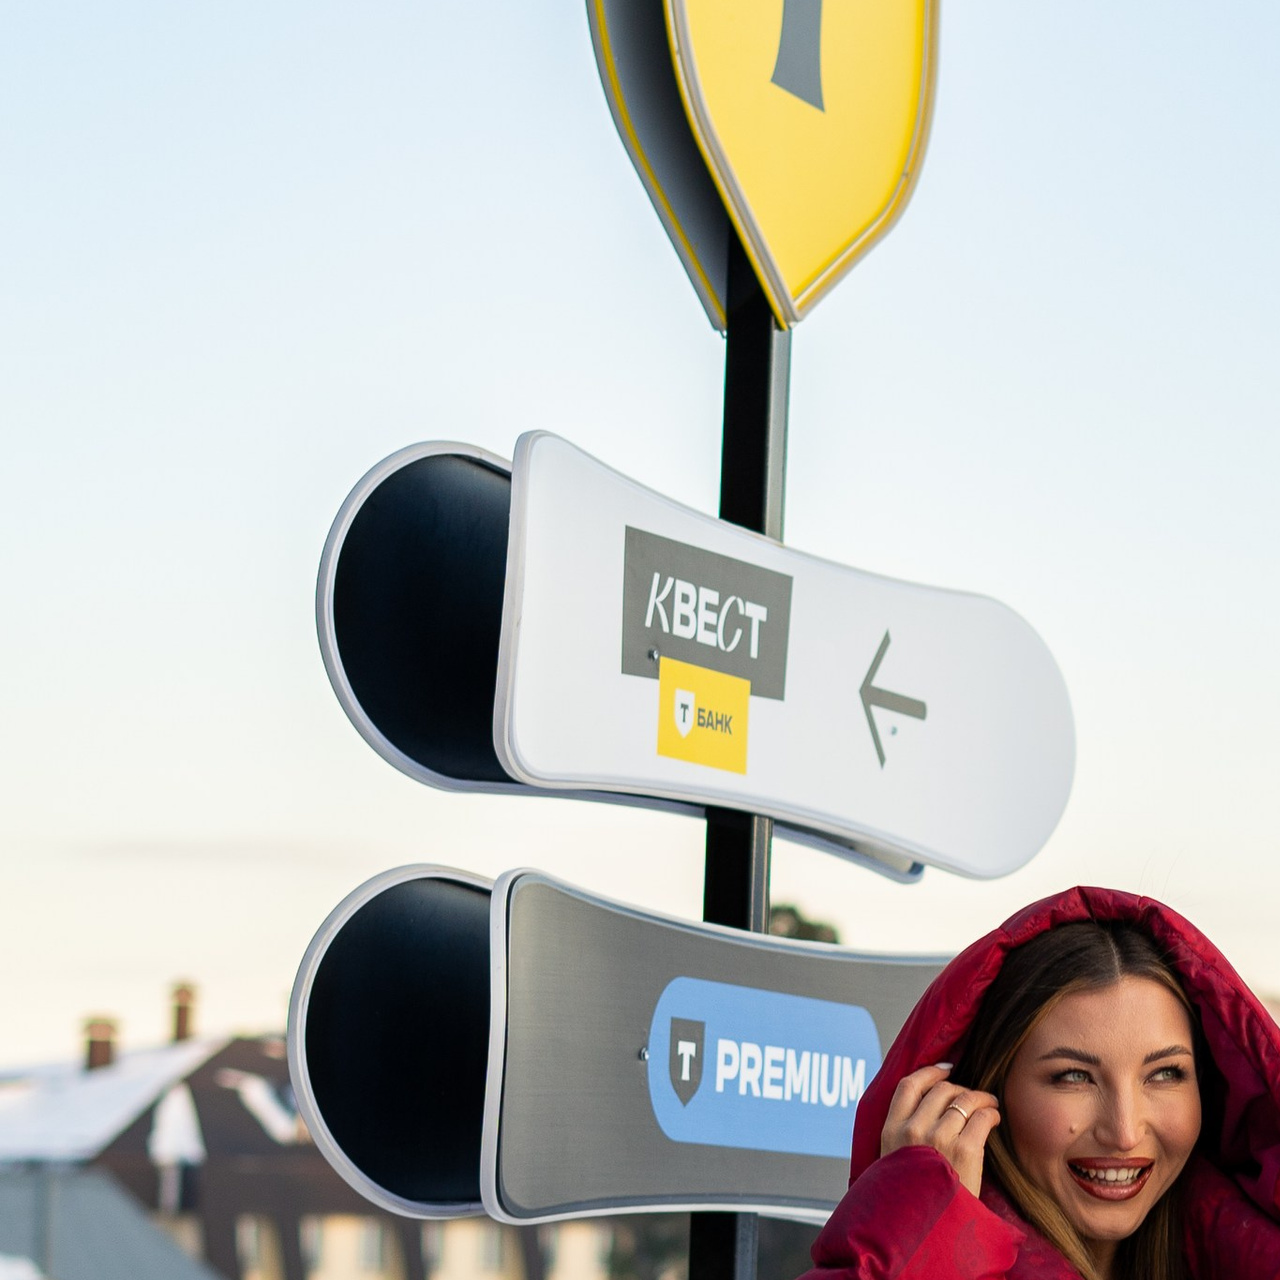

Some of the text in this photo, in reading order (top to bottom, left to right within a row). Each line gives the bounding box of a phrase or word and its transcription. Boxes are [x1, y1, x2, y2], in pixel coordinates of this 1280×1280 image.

[645, 572, 768, 659] КВЕСТ
[697, 707, 733, 735] БАНК
[715, 1038, 866, 1108] PREMIUM
